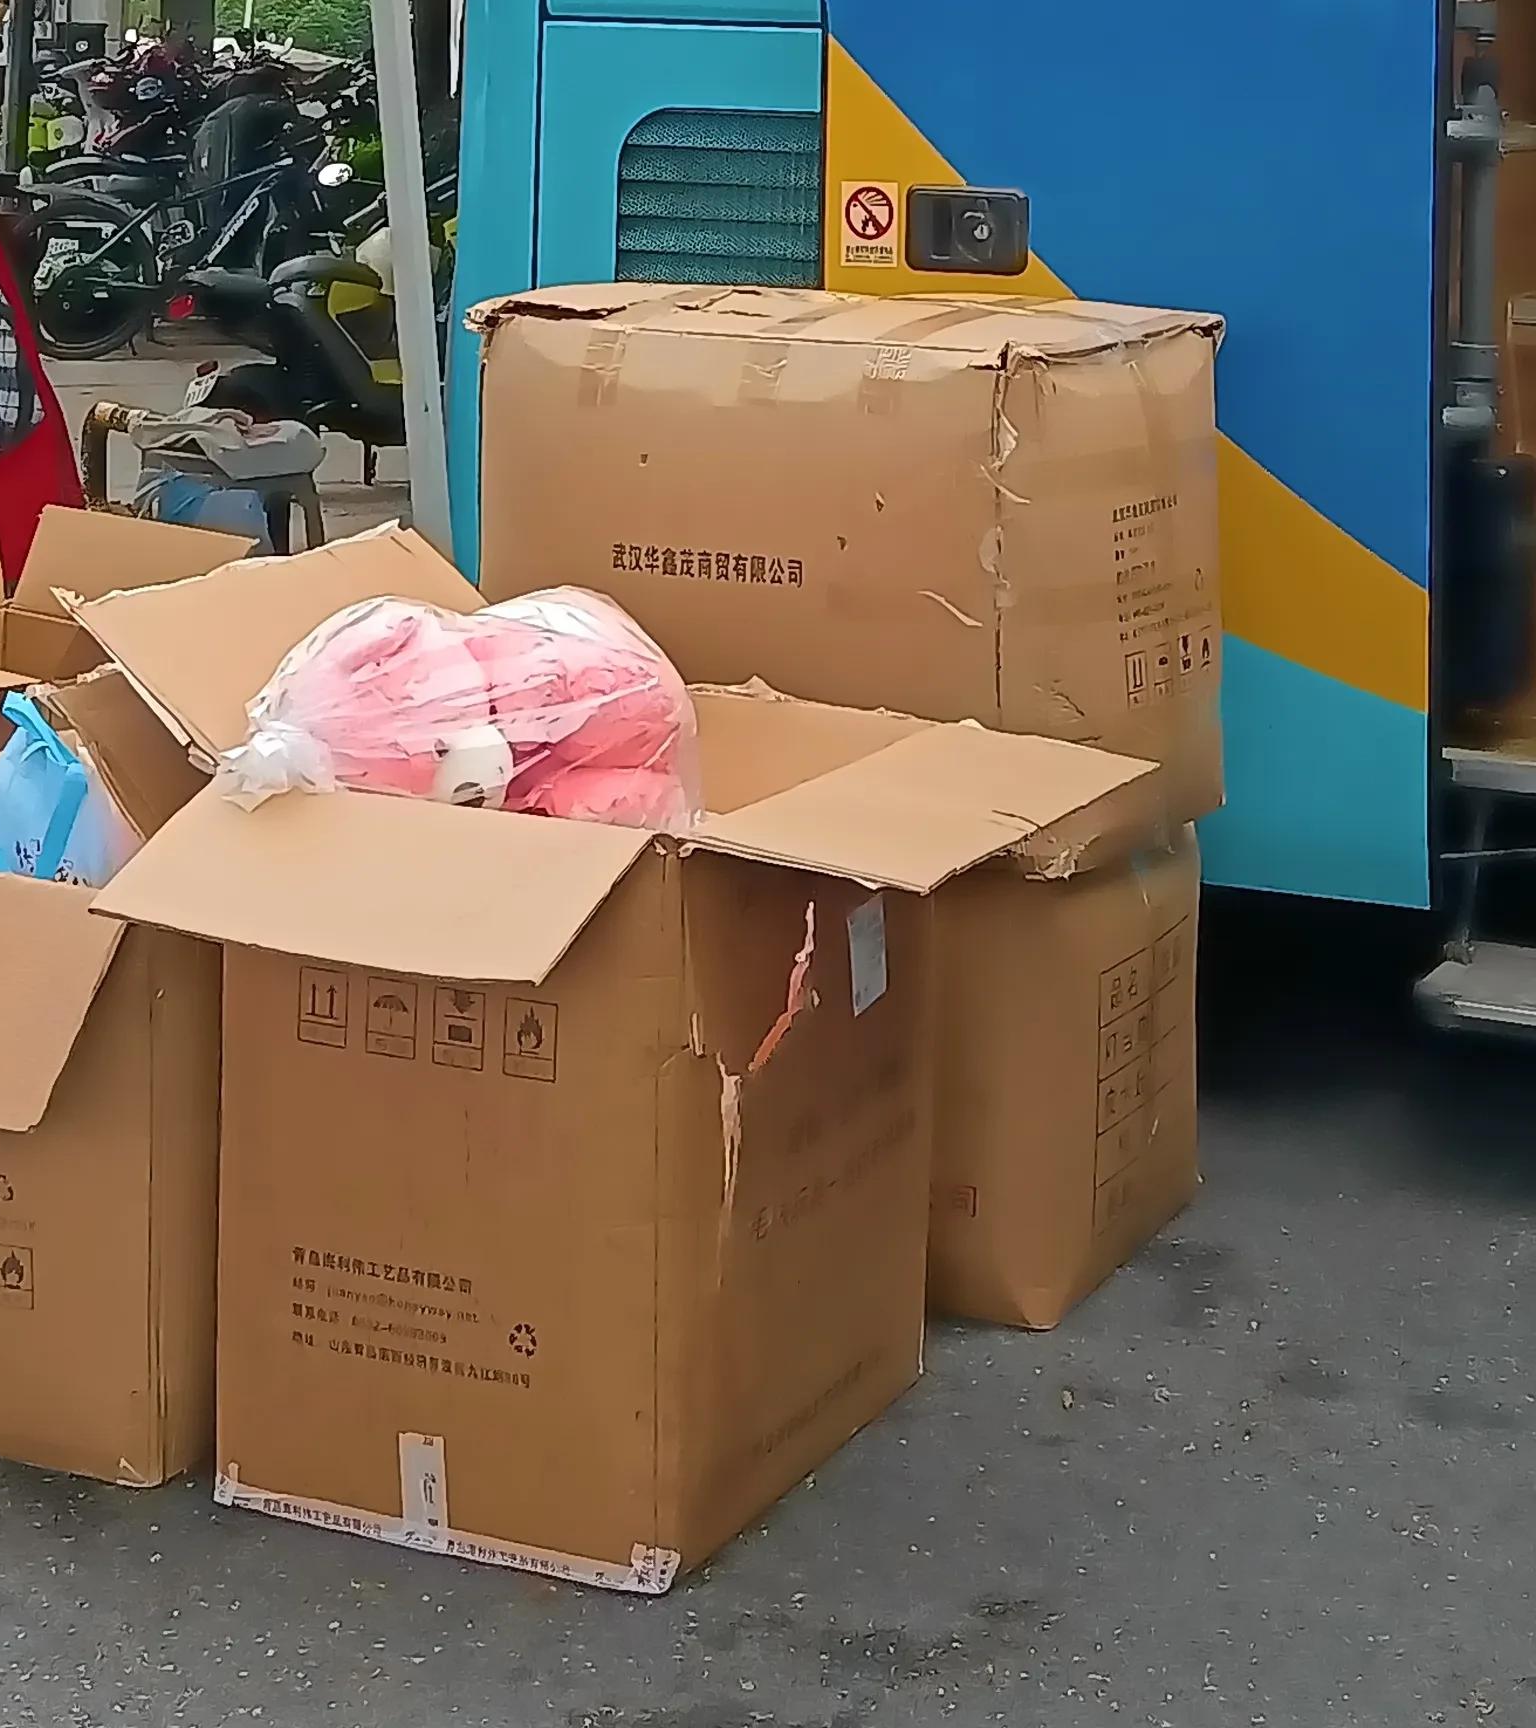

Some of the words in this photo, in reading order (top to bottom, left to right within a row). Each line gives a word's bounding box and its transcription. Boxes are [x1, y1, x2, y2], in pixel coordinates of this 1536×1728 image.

[612, 542, 805, 589] 武汉华鑫茂商贸有限公司
